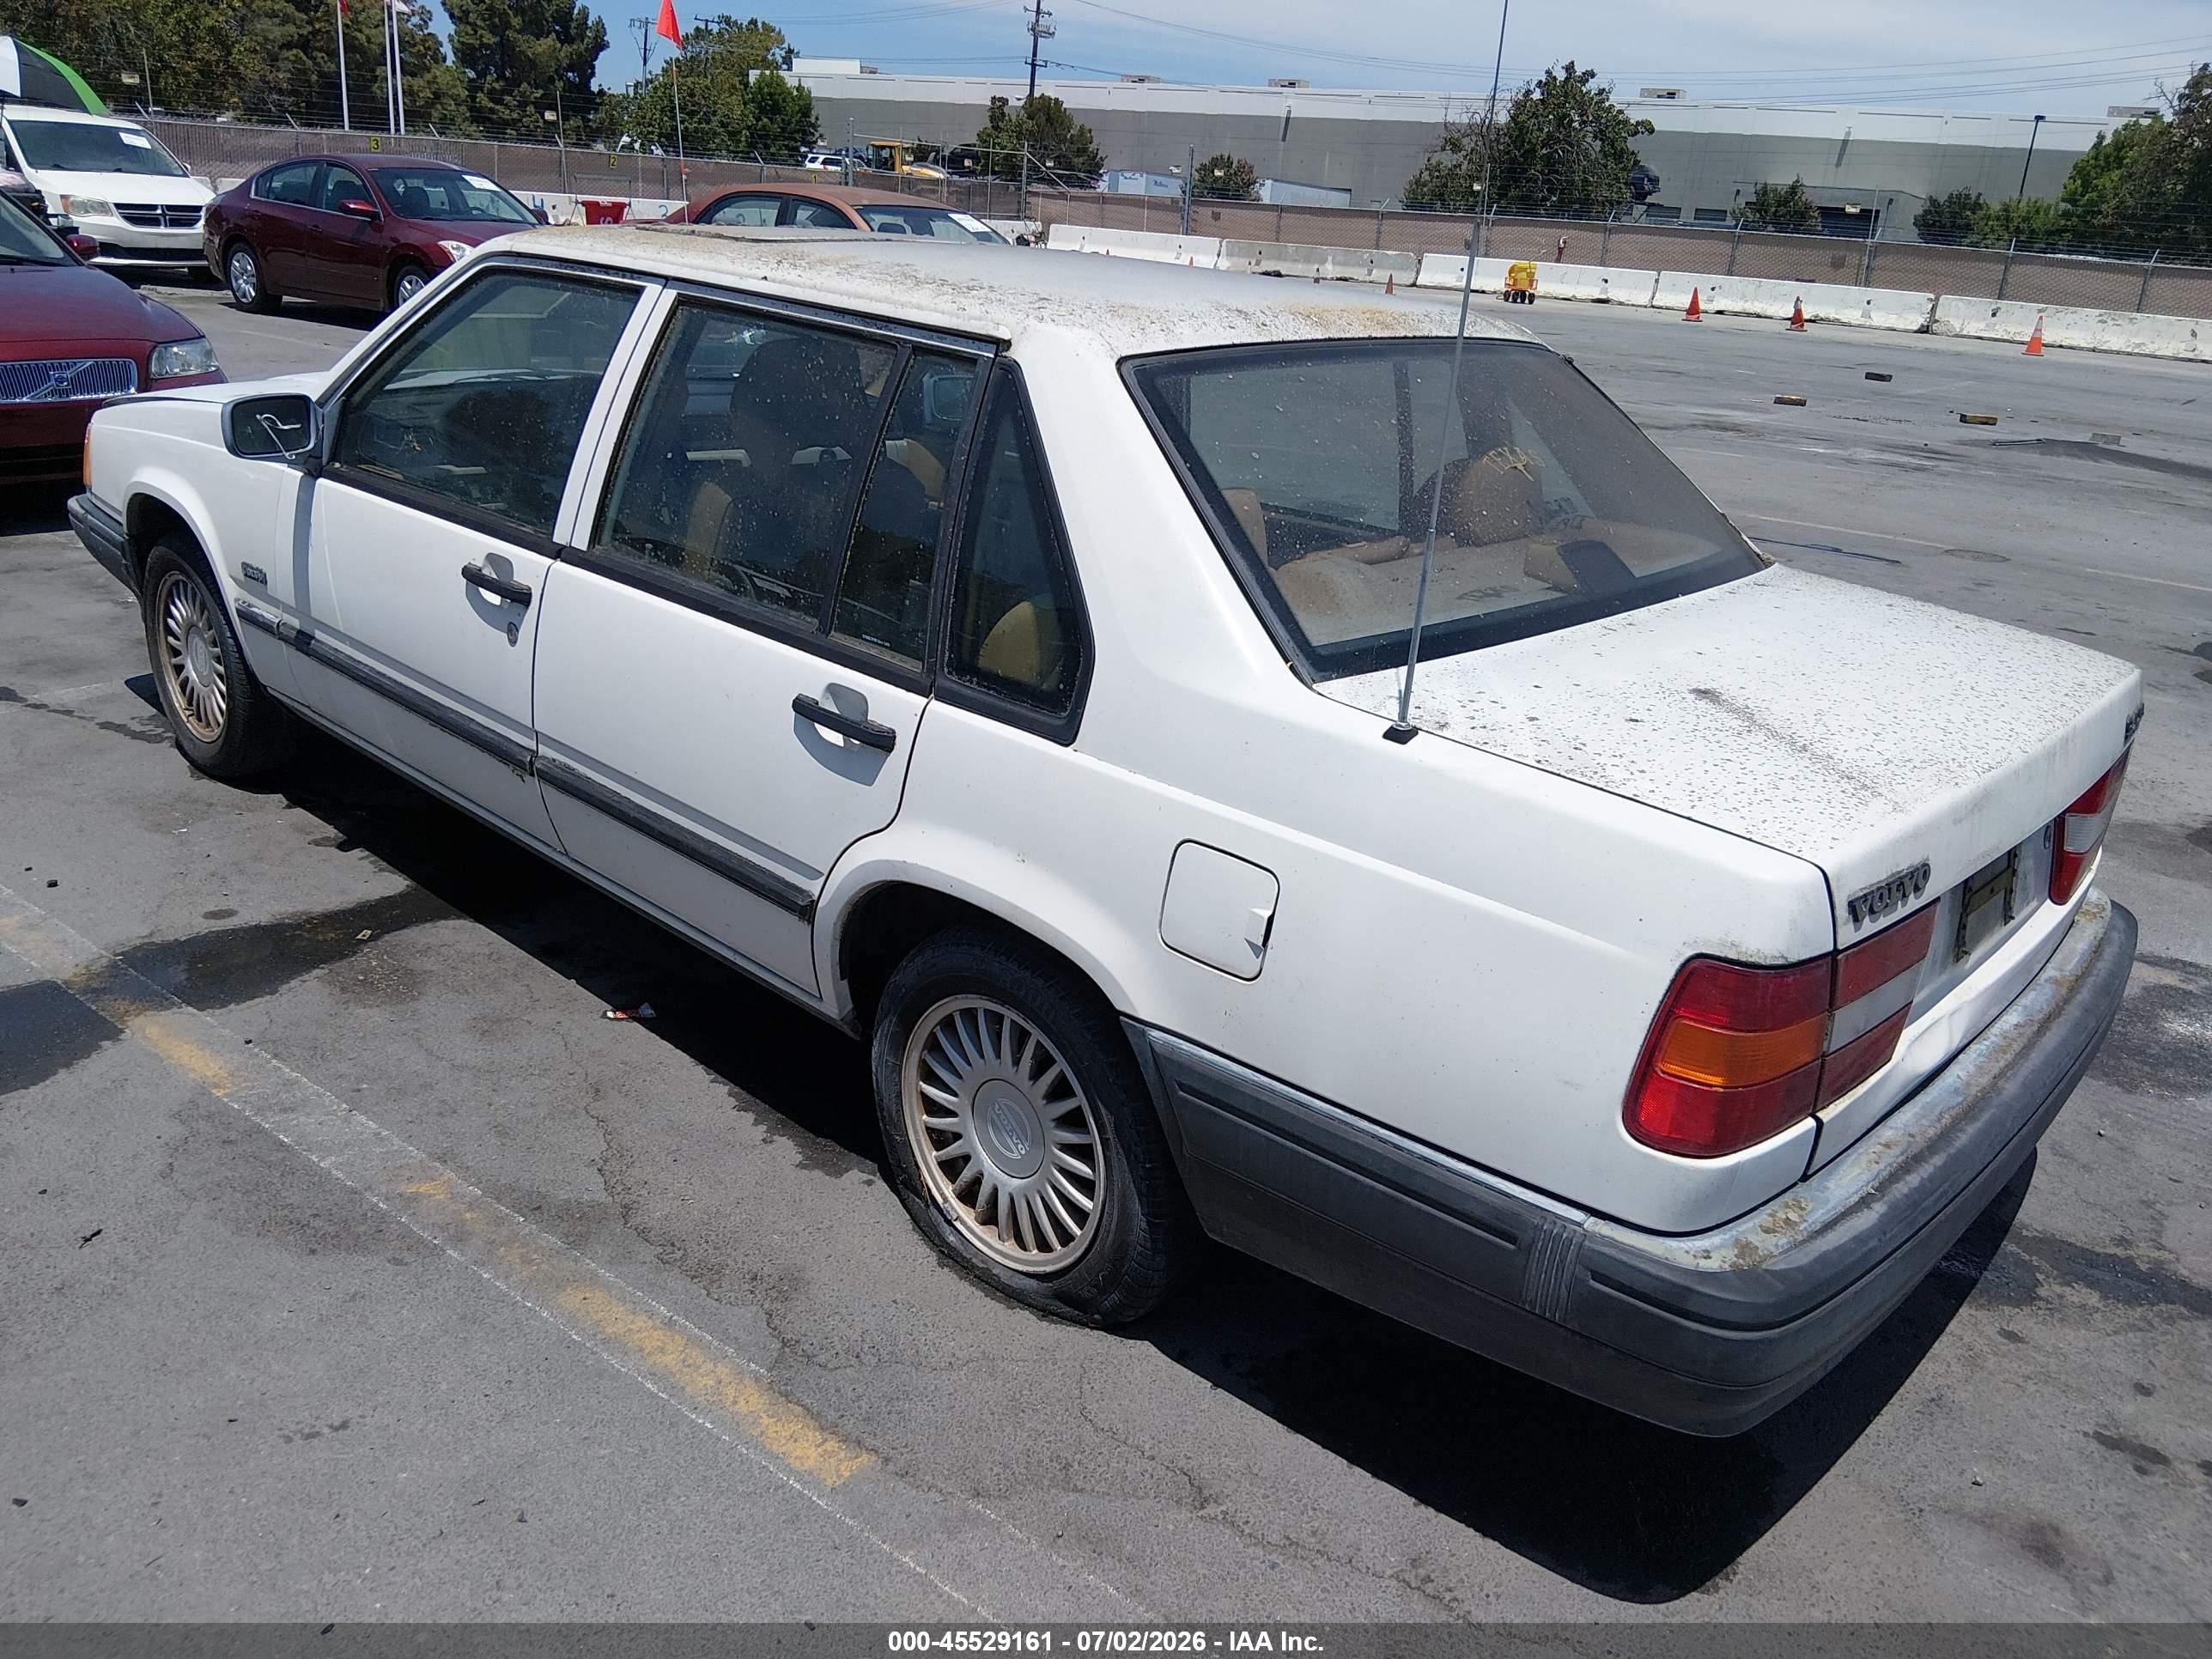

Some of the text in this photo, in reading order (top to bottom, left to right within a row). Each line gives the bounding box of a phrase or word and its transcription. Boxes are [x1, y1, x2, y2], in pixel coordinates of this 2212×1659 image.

[372, 138, 380, 150] 3
[611, 155, 617, 167] 2
[1483, 447, 1546, 475] TEXAS
[1847, 862, 1931, 924] VOLVO
[994, 1102, 1026, 1155] VOLVO
